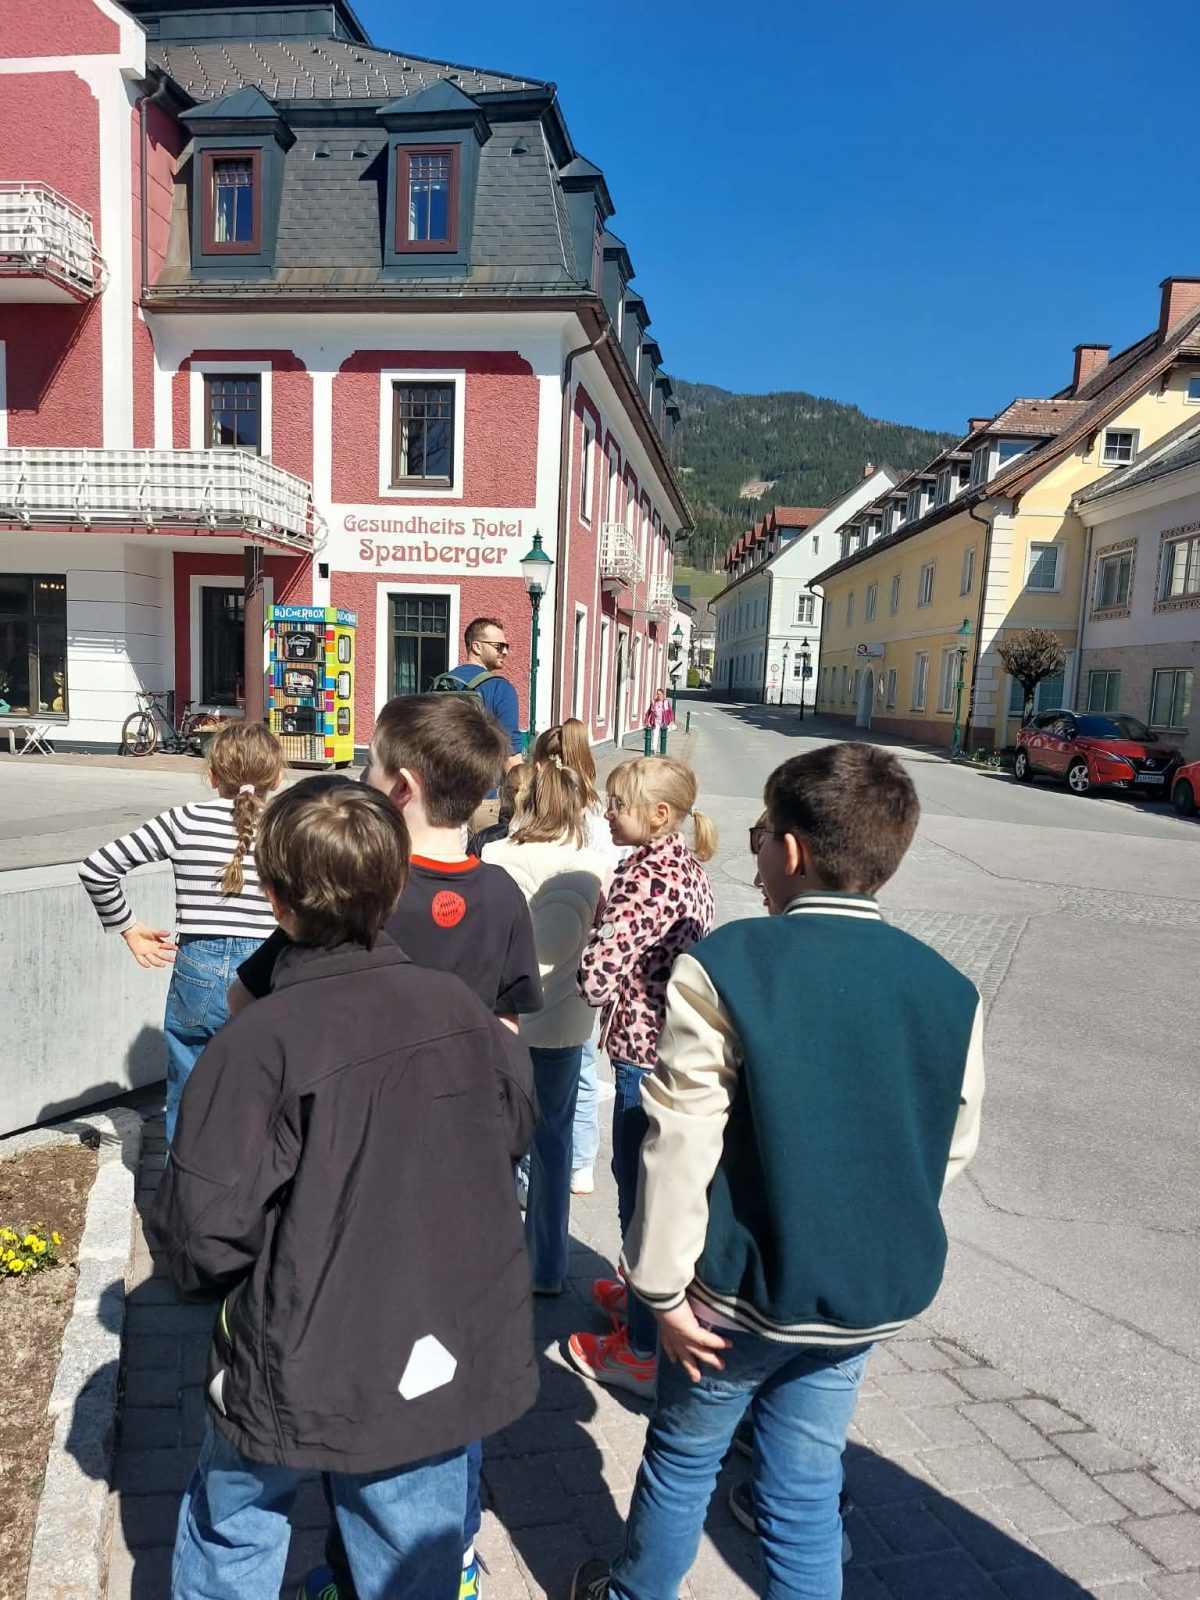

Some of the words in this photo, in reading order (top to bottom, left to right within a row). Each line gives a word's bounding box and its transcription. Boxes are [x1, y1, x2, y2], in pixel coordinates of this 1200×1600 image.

[343, 514, 466, 536] Gesundheits
[472, 518, 523, 540] Hotel
[359, 538, 508, 568] Spanberger
